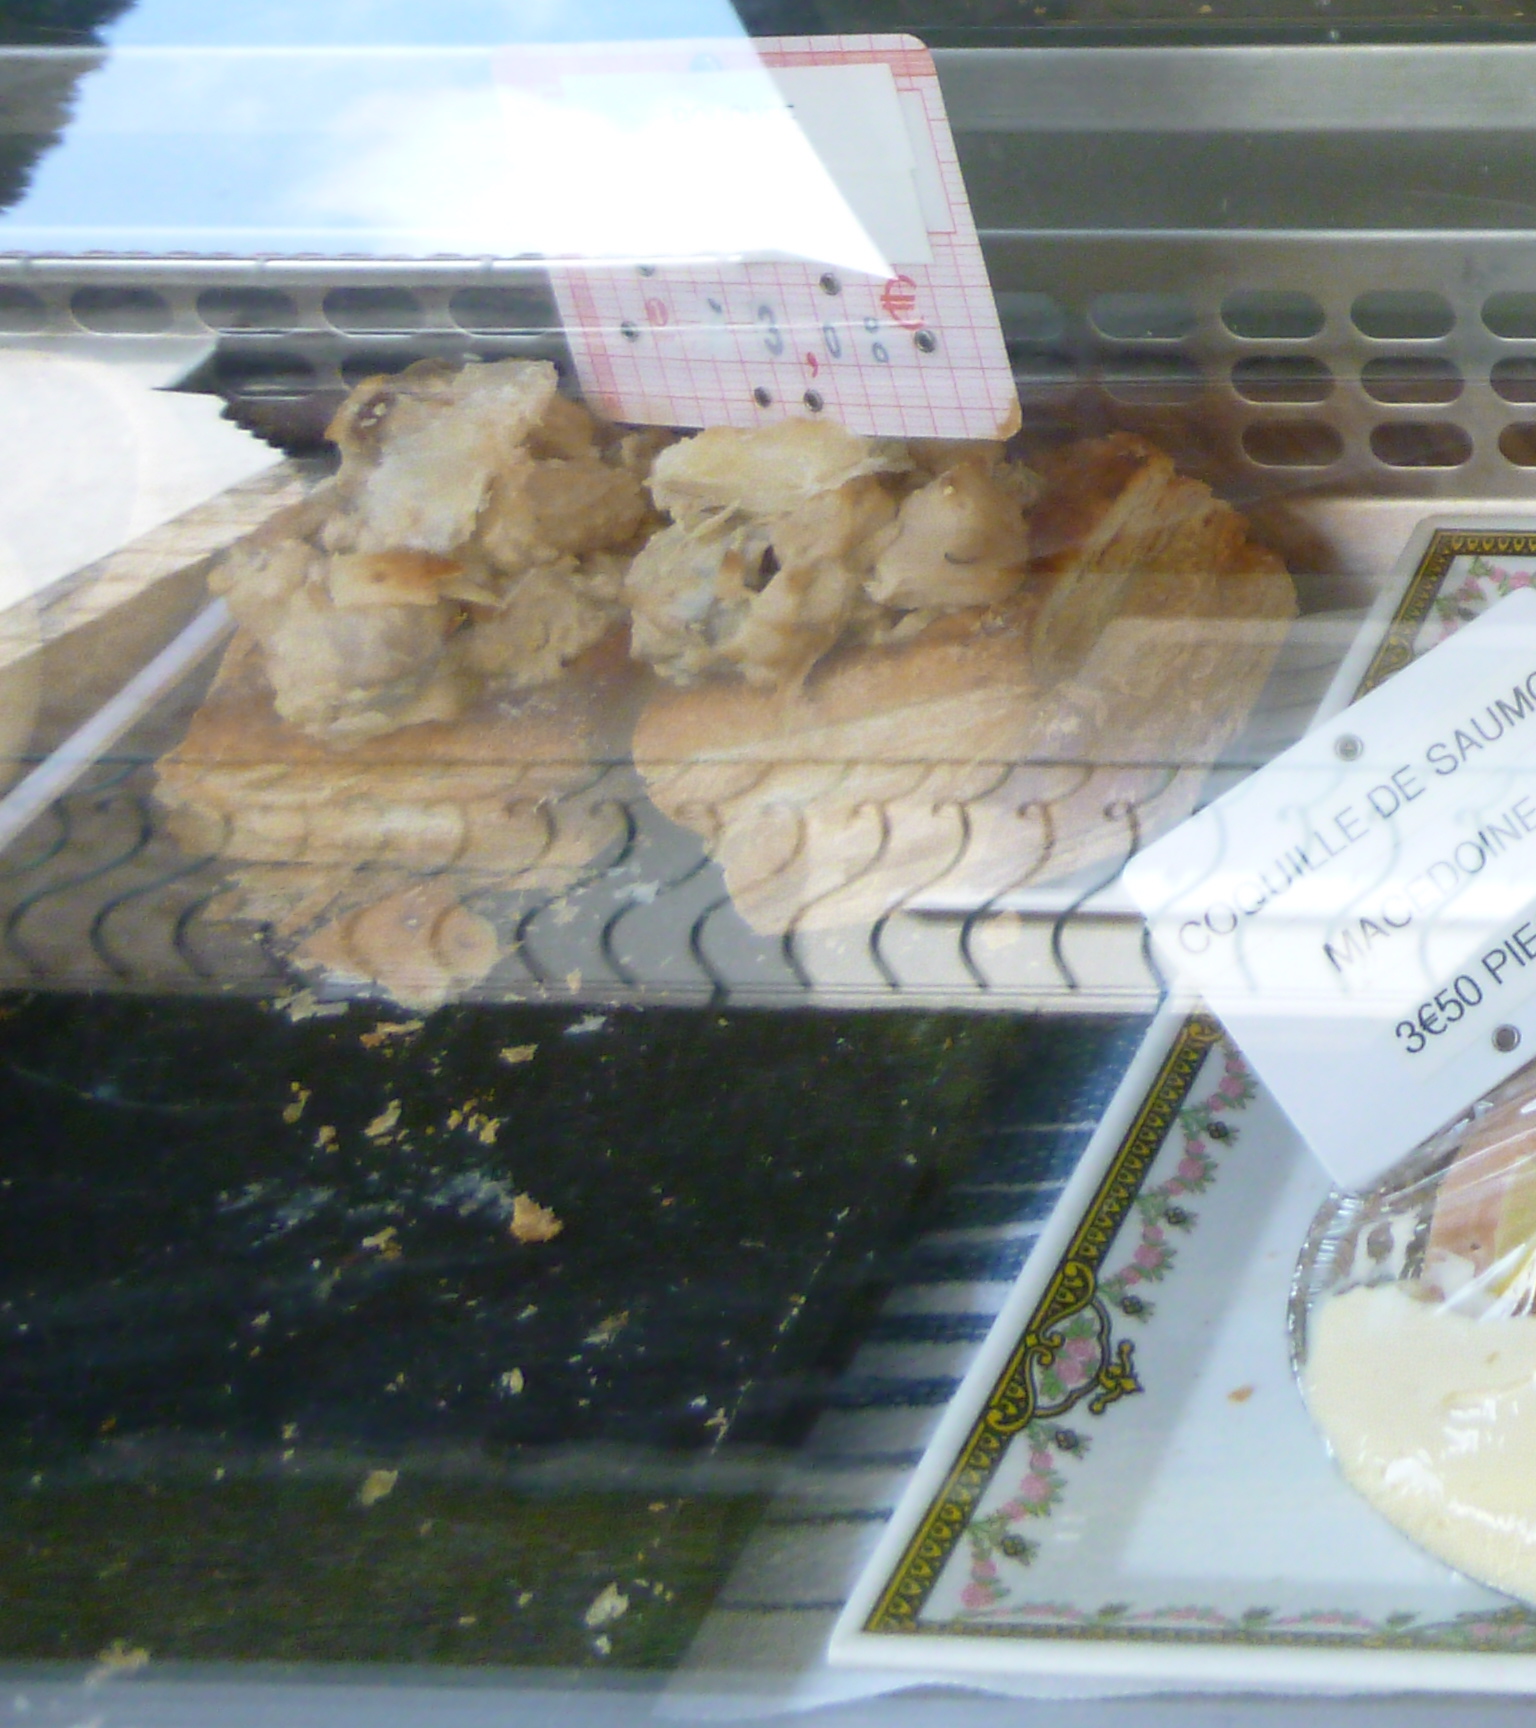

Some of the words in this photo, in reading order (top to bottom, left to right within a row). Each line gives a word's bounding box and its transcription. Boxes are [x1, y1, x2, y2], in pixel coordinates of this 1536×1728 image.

[1177, 804, 1372, 957] COQUILLE
[1366, 764, 1427, 822] DE
[1394, 973, 1484, 1056] 3€50
